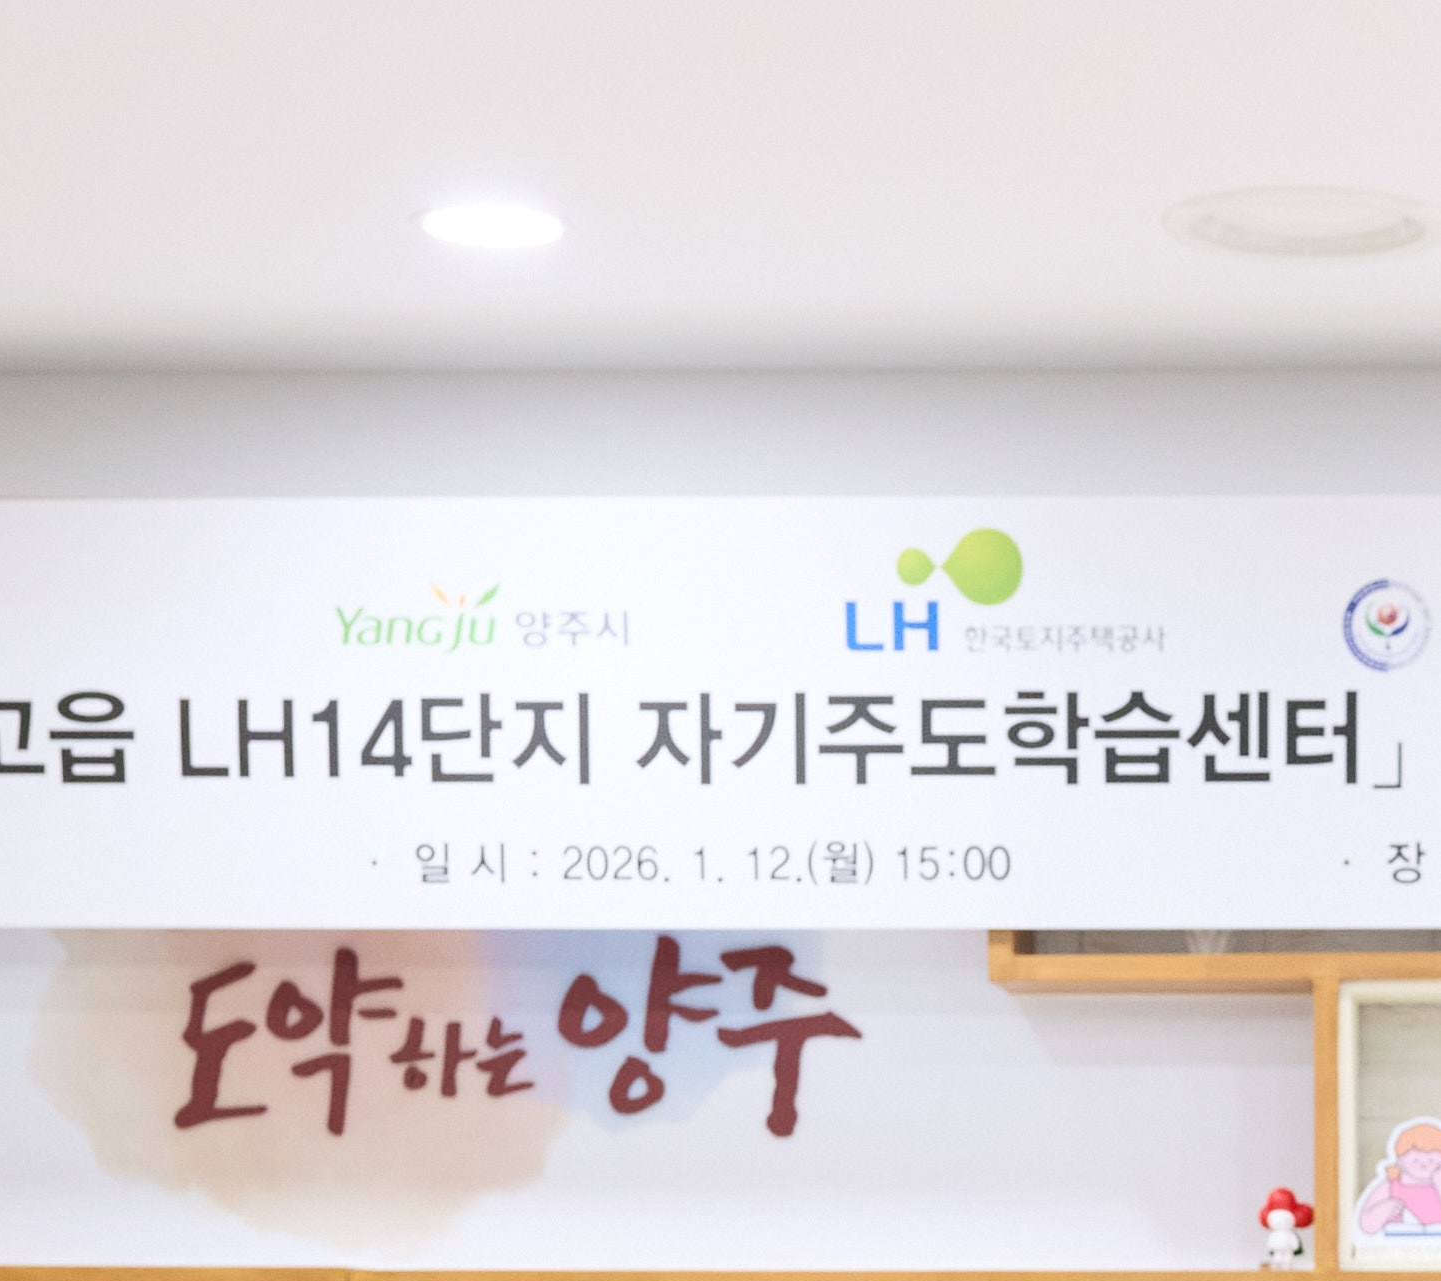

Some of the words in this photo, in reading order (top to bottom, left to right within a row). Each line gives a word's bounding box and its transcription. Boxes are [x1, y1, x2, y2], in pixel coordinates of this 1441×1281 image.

[515, 612, 628, 646] 양주시
[846, 601, 938, 651] LH
[966, 626, 1165, 652] 한국토지주택공사
[179, 693, 589, 784] LH14단지
[638, 691, 1401, 788] 자기주도학습센터」
[563, 846, 669, 882] 2026.
[695, 848, 723, 883] 1.
[749, 842, 874, 883] 12.(월)
[898, 845, 1011, 881] 15:00
[174, 945, 533, 1136] 도약하는
[557, 934, 861, 1137] 양주
